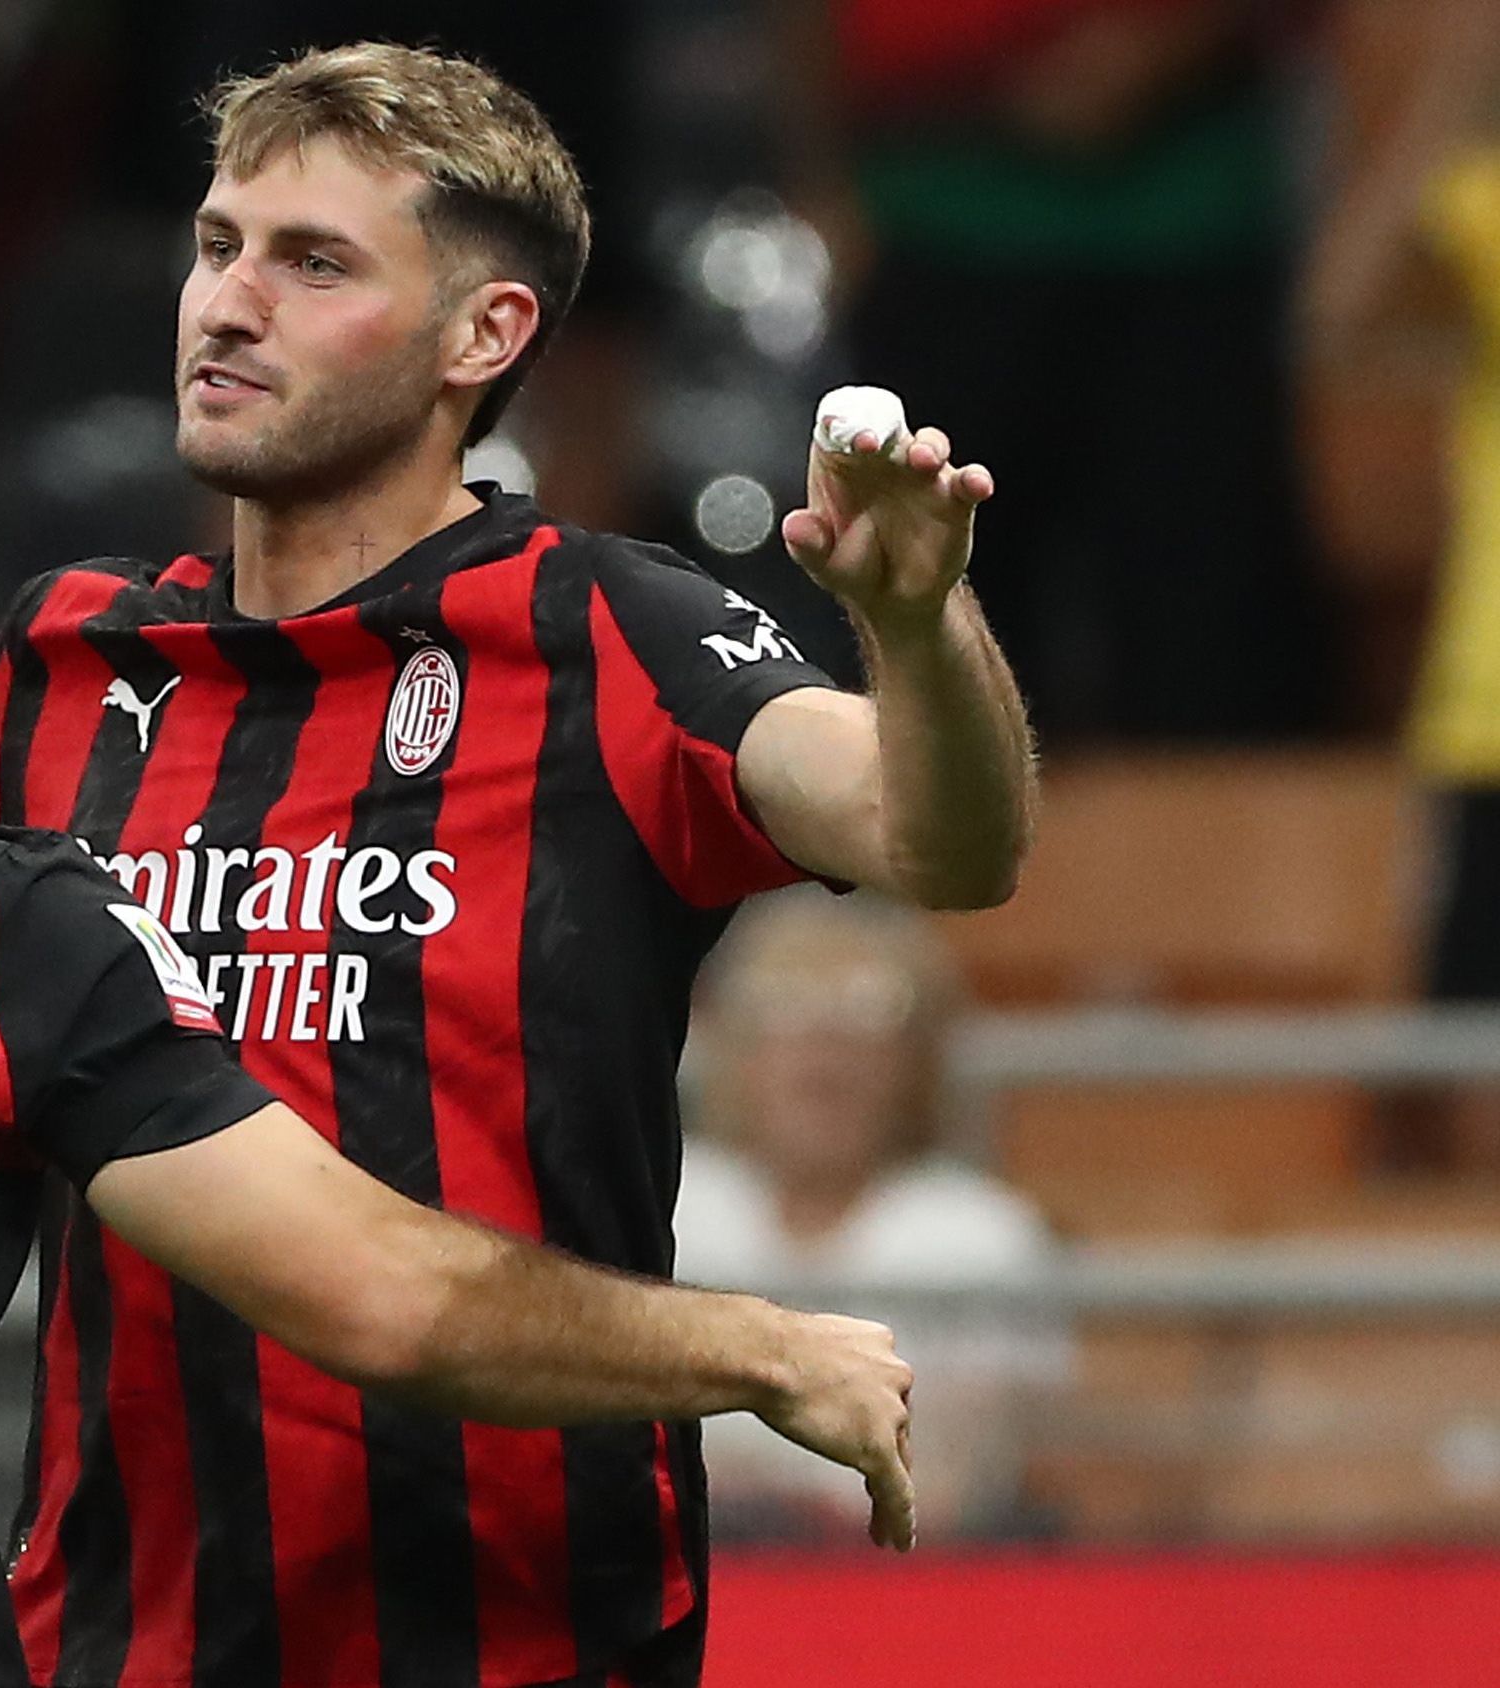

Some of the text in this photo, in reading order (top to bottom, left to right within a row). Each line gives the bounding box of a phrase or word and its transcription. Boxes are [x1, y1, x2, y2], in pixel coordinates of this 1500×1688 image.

[411, 656, 449, 682] ACM
[76, 824, 458, 936] mirates
[188, 953, 369, 1041] ETTER
